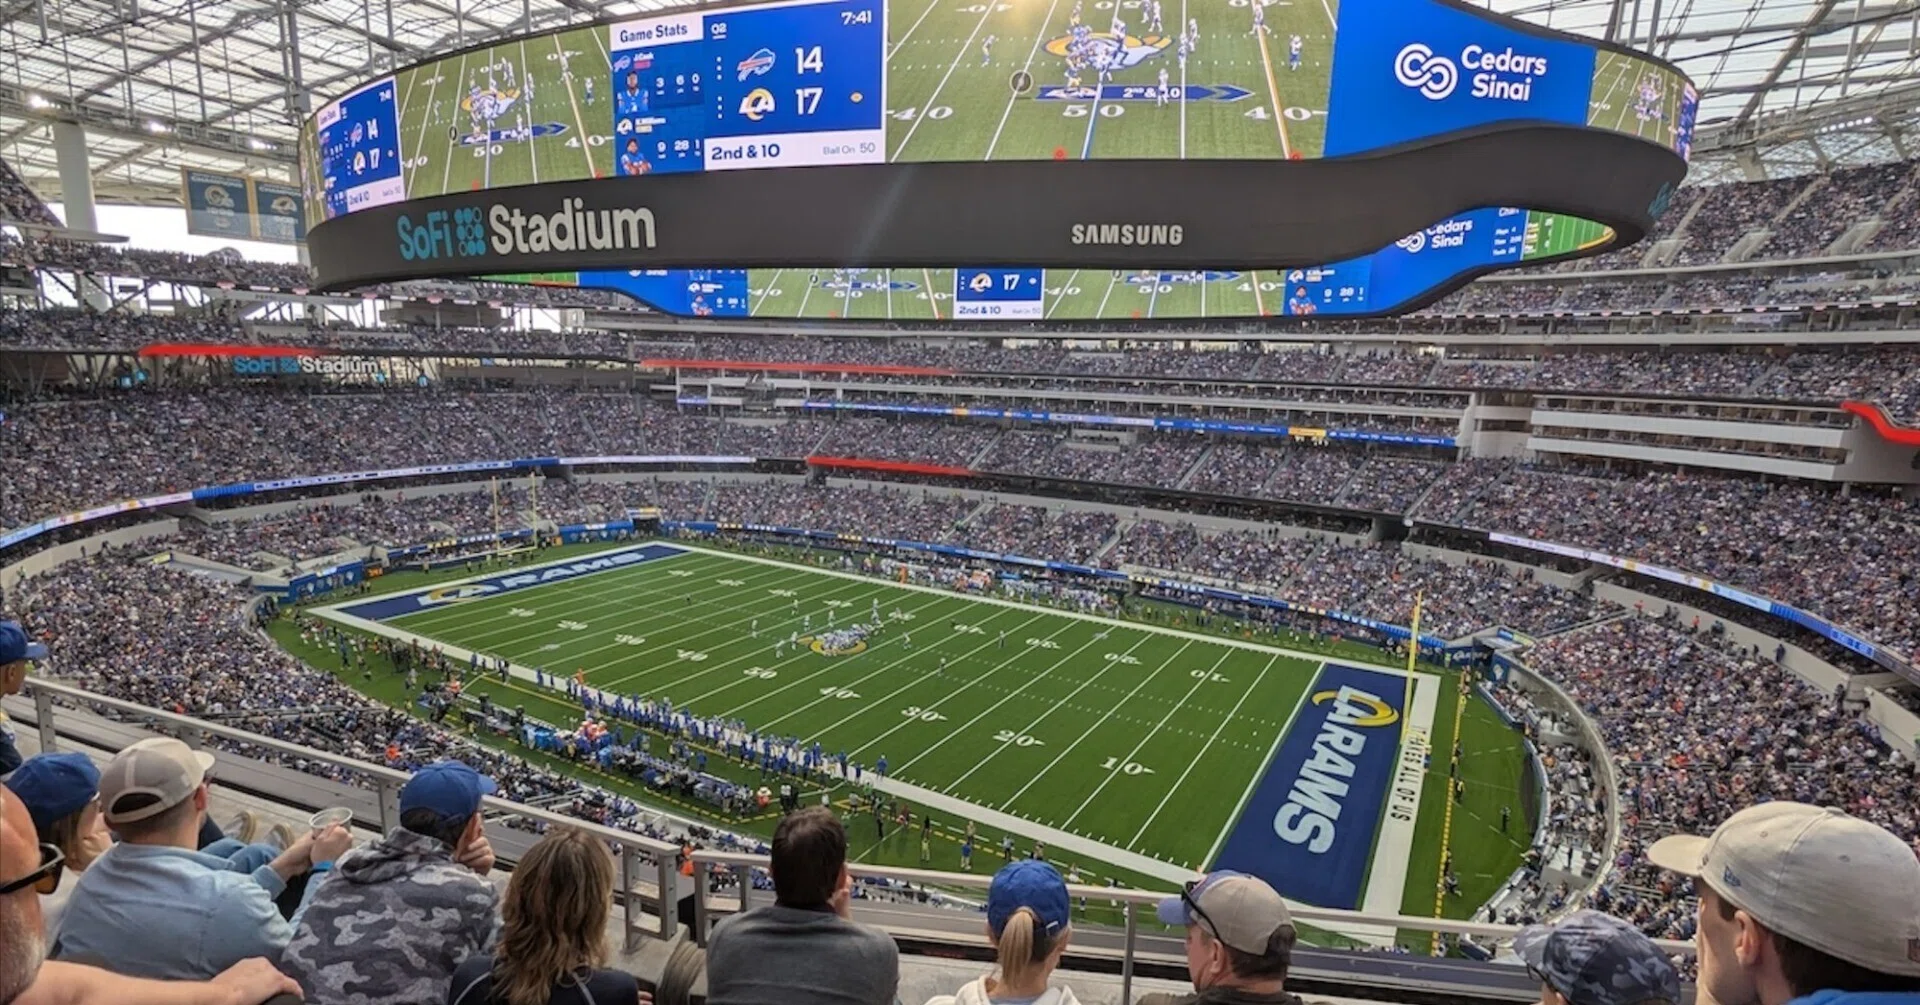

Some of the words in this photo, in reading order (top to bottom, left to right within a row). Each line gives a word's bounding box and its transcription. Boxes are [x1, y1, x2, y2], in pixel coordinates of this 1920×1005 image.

[841, 10, 872, 25] 7:41
[620, 29, 653, 43] Game
[656, 24, 688, 38] Stats
[795, 46, 824, 75] 14
[1461, 44, 1547, 77] Cedars
[1471, 72, 1532, 102] Sinai
[795, 87, 824, 116] 17
[893, 106, 953, 120] 40
[1062, 104, 1125, 118] 50
[1244, 106, 1312, 121] 40
[473, 144, 503, 157] 50
[711, 146, 743, 160] 2nd
[746, 145, 758, 159] &
[761, 143, 781, 158] 10
[859, 142, 876, 154] 50
[397, 210, 453, 260] SoFi
[489, 197, 656, 255] Stadium
[1071, 224, 1183, 246] SAMSUNG
[1431, 232, 1464, 249] Sinai
[1003, 274, 1020, 291] 17
[959, 306, 979, 315] 2nd
[981, 306, 988, 315] &
[990, 305, 1001, 315] 10
[235, 355, 277, 373] SoFi
[302, 355, 378, 374] Stadium
[501, 552, 645, 588] RAMS
[901, 706, 940, 722] 30
[993, 729, 1036, 747] 20
[1100, 756, 1144, 775] 10
[1399, 766, 1420, 784] ALL
[1273, 722, 1367, 854] RAMS
[1395, 788, 1416, 803] OF
[1390, 805, 1413, 821] US
